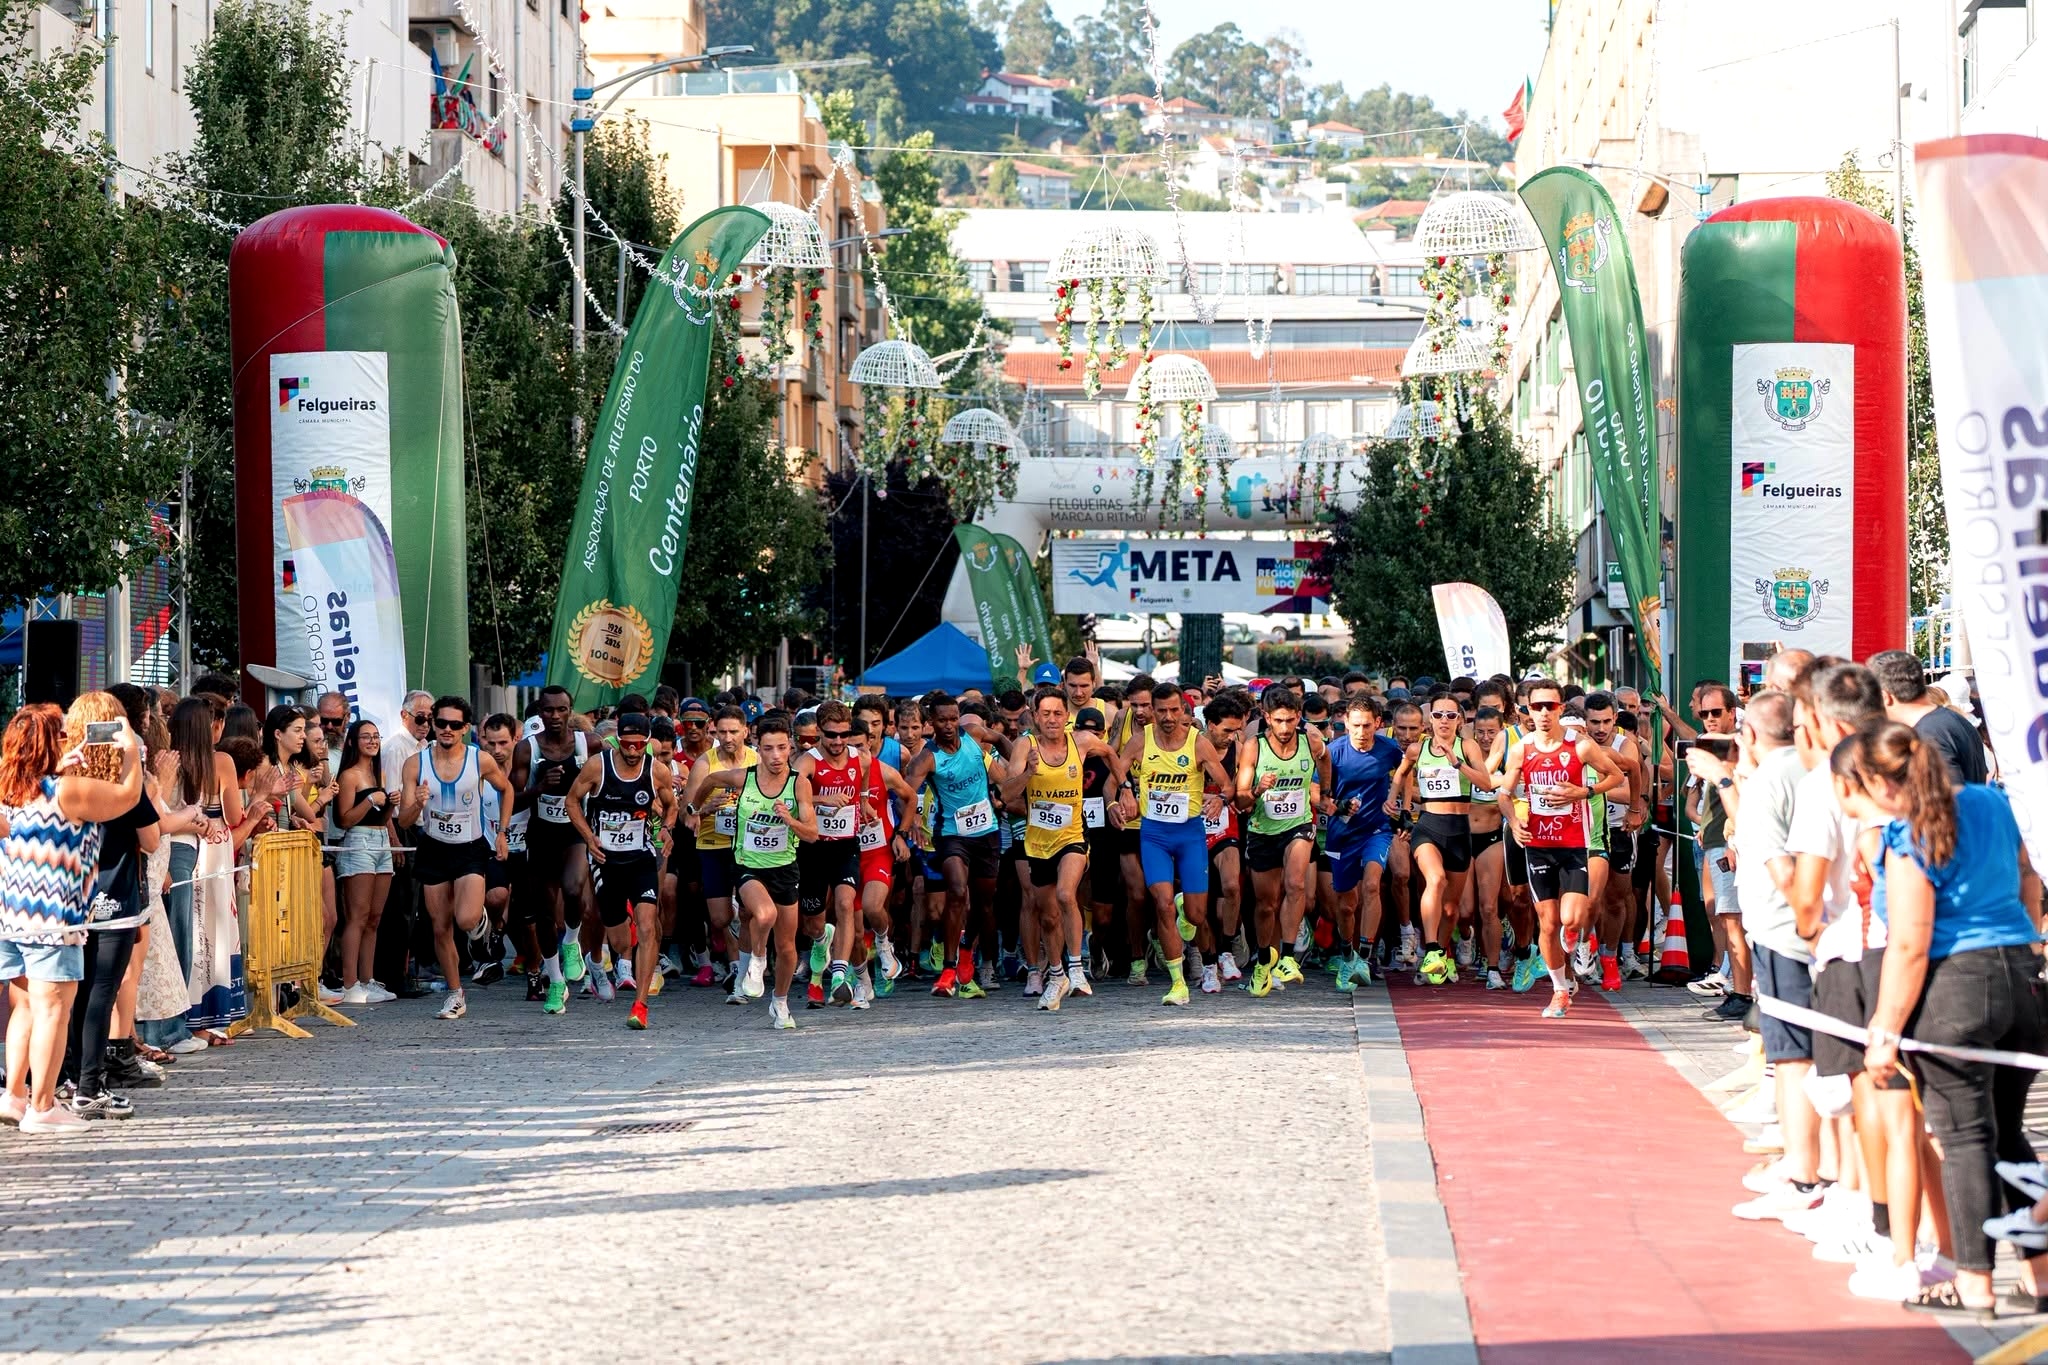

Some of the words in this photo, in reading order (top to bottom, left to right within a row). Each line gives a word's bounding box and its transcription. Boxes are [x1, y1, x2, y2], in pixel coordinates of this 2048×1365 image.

[630, 350, 645, 375] DO
[298, 397, 377, 415] Felgueiras
[607, 376, 637, 458] ATLETISMO
[602, 455, 616, 480] DE
[629, 435, 658, 503] PORTO
[649, 404, 702, 577] Centenário
[1763, 484, 1842, 500] Felgueiras
[1049, 498, 1124, 511] FELGUEIRAS
[1050, 512, 1093, 521] MARCA
[1095, 512, 1104, 522] O
[583, 480, 610, 574] ASSOCIAÇÃO
[1130, 550, 1241, 582] META
[1258, 569, 1312, 579] REGIONAL
[1258, 579, 1296, 588] FUNDO
[608, 622, 623, 634] 1926
[605, 637, 620, 648] 2026
[590, 649, 609, 660] 100
[610, 656, 624, 668] anos
[1276, 778, 1304, 787] mm
[1427, 780, 1450, 791] 653
[1046, 789, 1079, 798] VÁRZEA
[546, 806, 568, 816] 678
[1155, 803, 1179, 815] 970
[1274, 802, 1297, 814] 639
[823, 818, 846, 830] 930
[965, 813, 987, 827] 873
[1039, 811, 1062, 825] 958
[438, 822, 462, 834] 853
[1538, 816, 1564, 835] MS
[610, 832, 634, 843] 784
[754, 836, 779, 847] 655
